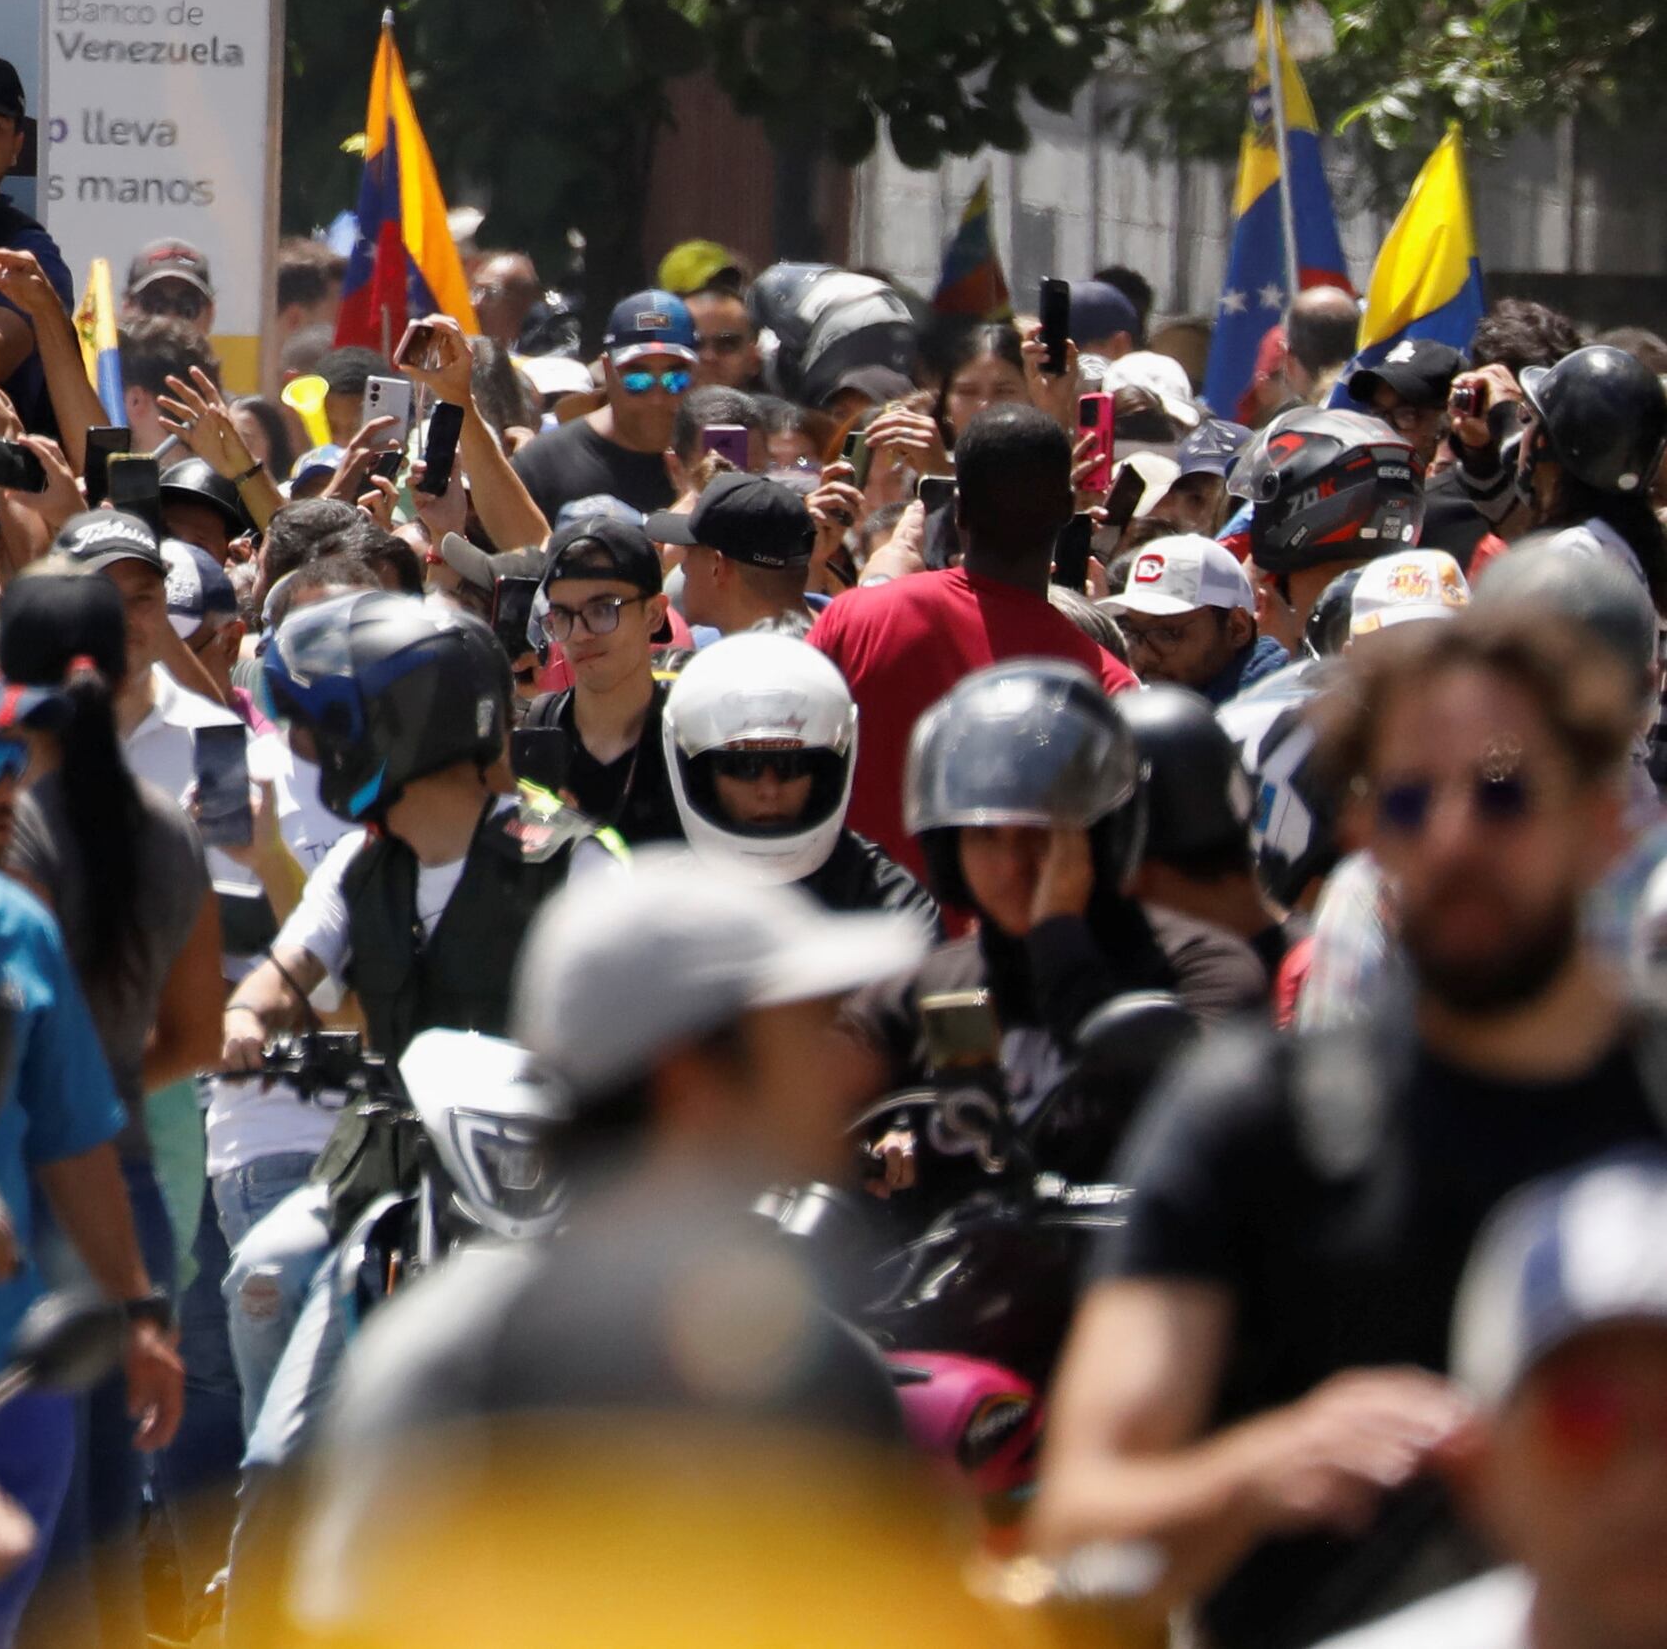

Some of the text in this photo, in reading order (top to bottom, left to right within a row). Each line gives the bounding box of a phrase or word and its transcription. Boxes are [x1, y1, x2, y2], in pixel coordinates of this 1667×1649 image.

[166, 0, 205, 27] de
[54, 30, 246, 67] Venezuela
[81, 107, 179, 148] lleva
[77, 175, 216, 208] manos
[1377, 465, 1411, 481] EDGE
